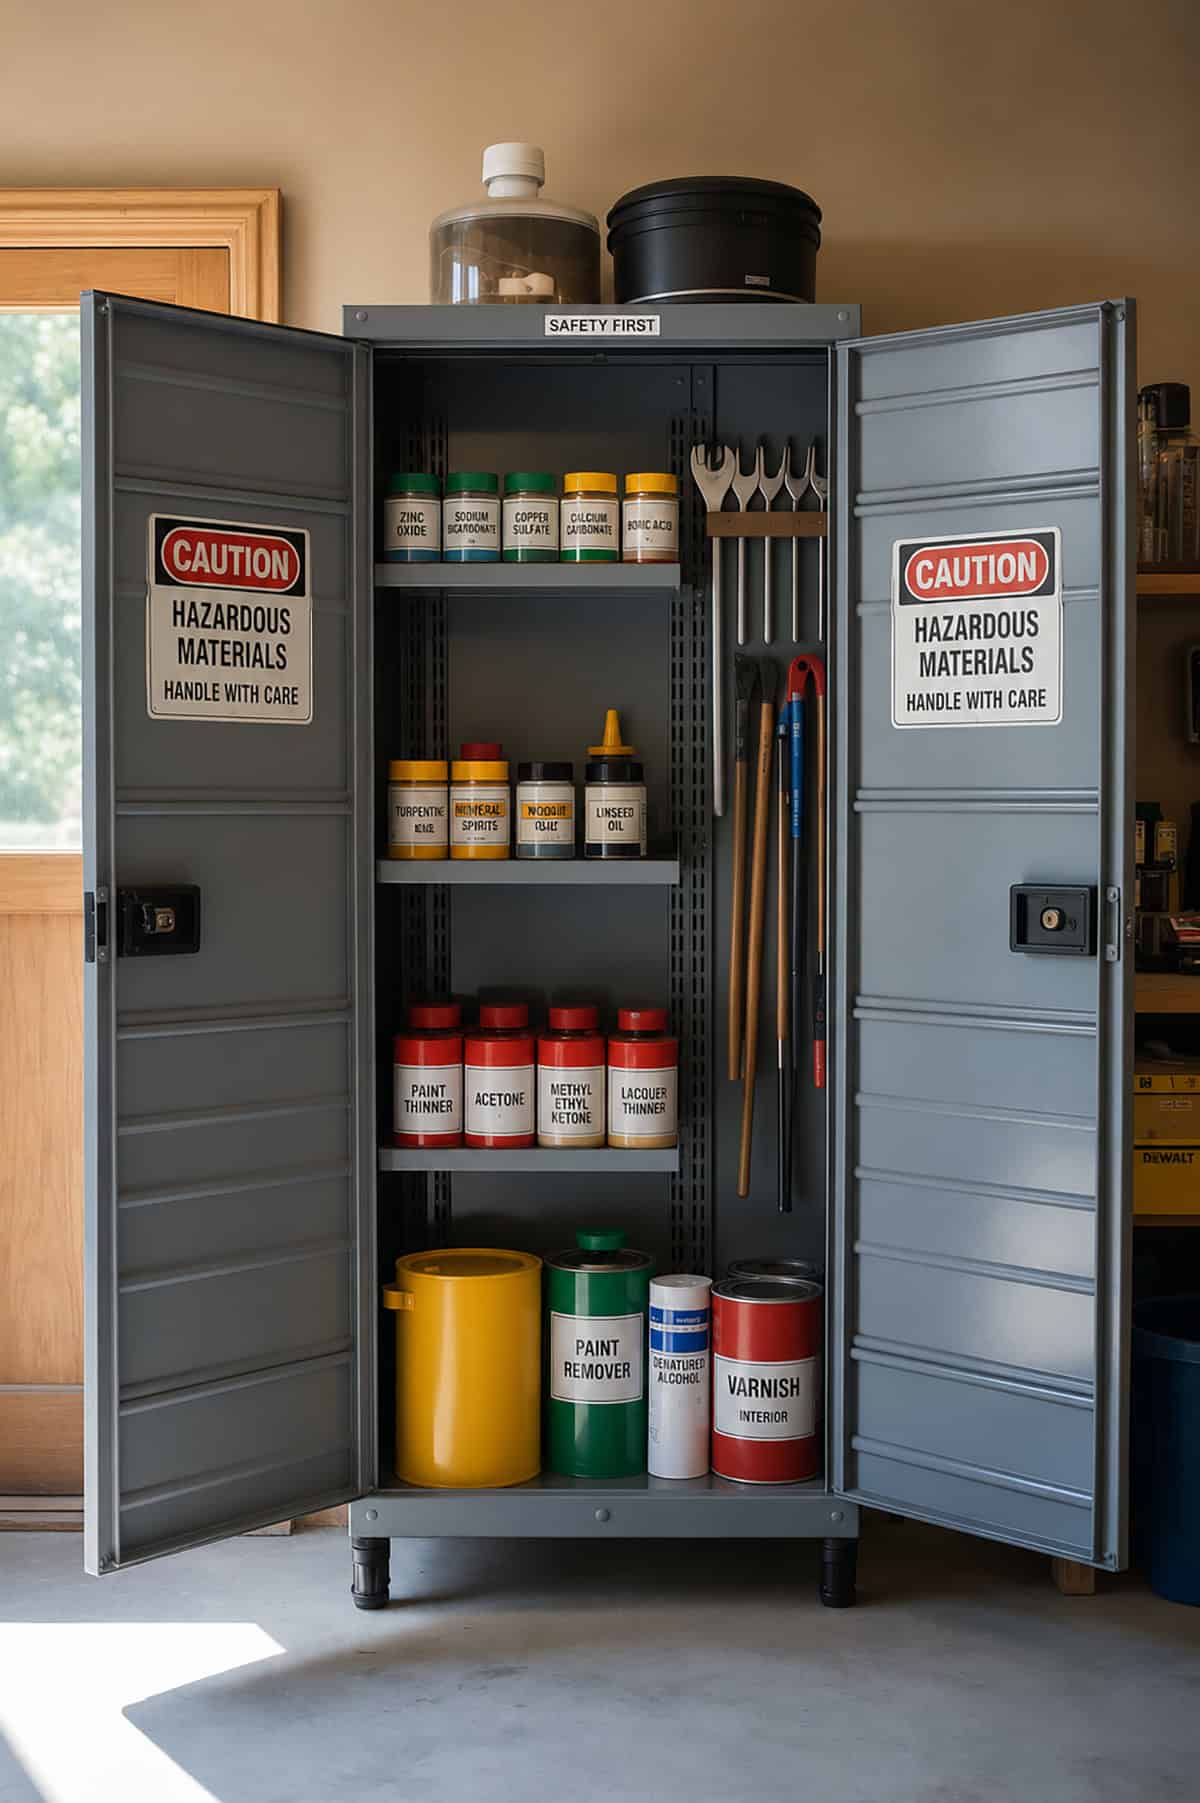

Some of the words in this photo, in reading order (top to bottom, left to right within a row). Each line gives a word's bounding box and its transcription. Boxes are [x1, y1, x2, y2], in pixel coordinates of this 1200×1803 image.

[550, 318, 607, 332] SAFETY
[613, 318, 655, 332] FIRST
[400, 512, 424, 523] ZINC
[455, 512, 488, 522] SODIUM
[515, 512, 548, 523] COPPER
[570, 512, 607, 523] CALCIUM
[396, 525, 427, 536] OXIDE
[512, 524, 550, 535] SULFATE
[173, 539, 288, 580] CAUTION
[916, 551, 1036, 590] CAUTION
[173, 600, 290, 634] HAZARDOUS
[915, 610, 1039, 643] HAZARDOUS
[178, 637, 287, 670] MATERIALS
[920, 646, 1034, 677] MATERIALS
[164, 680, 220, 701] HANDLE
[224, 684, 259, 703] WITH
[264, 686, 298, 705] CARE
[907, 692, 961, 712] HANDLE
[966, 690, 1002, 709] WITH
[1008, 689, 1046, 708] CARE
[596, 807, 634, 818] LINSEED
[462, 820, 498, 831] SPIRITS
[608, 820, 624, 831] OIL
[412, 1085, 446, 1098] PAINT
[551, 1083, 592, 1096] METHYL
[621, 1087, 667, 1100] LACQUER
[475, 1092, 525, 1106] ACETONE
[555, 1098, 588, 1110] ETHYL
[404, 1100, 453, 1113] THINNER
[623, 1102, 666, 1115] THINNER
[552, 1112, 592, 1124] KETONE
[1144, 1152, 1194, 1164] DEWALT
[576, 1339, 619, 1358] PAINT
[654, 1357, 705, 1370] DENATURED
[564, 1361, 631, 1380] REMOVER
[658, 1372, 700, 1384] ALCOHOL
[727, 1376, 800, 1398] VARNISH
[739, 1410, 788, 1424] INTERIOR
